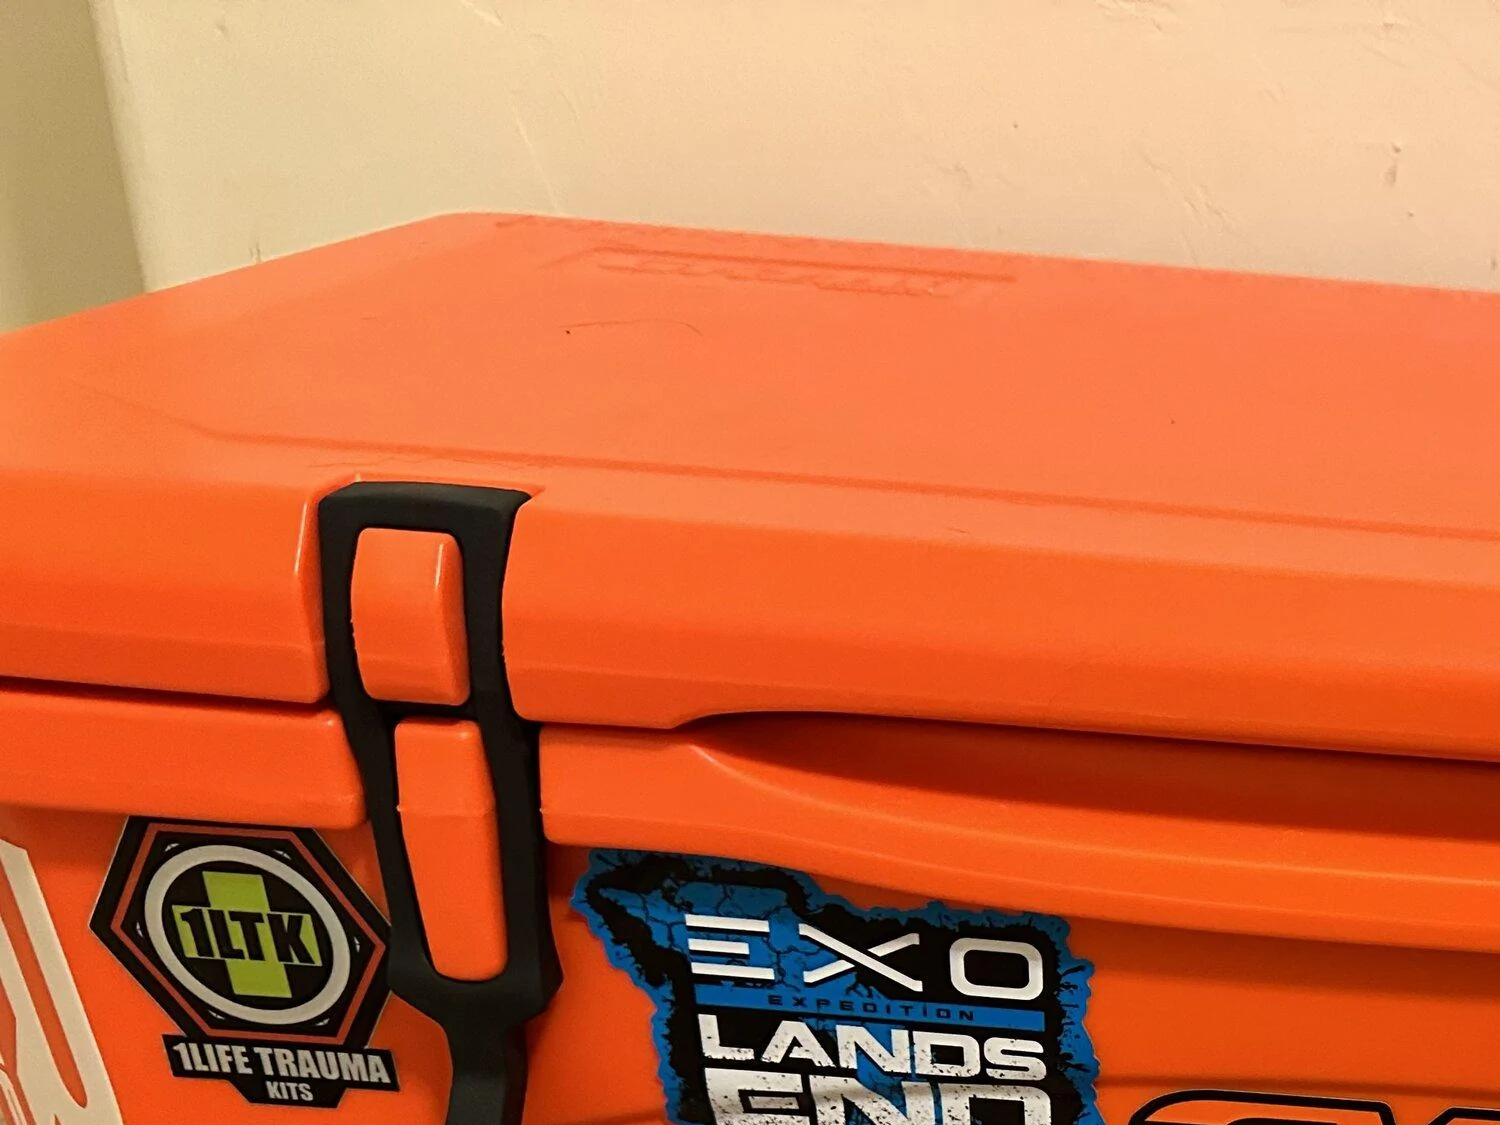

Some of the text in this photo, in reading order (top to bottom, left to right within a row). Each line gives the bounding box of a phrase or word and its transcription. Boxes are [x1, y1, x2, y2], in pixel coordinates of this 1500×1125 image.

[180, 908, 316, 965] 1LTK
[684, 912, 1044, 1001] EXO
[767, 994, 975, 1022] EXPEDITION
[172, 1042, 392, 1084] 1LIFE TRAUMA
[697, 1013, 1048, 1082] LANDS
[265, 1080, 314, 1101] KITS
